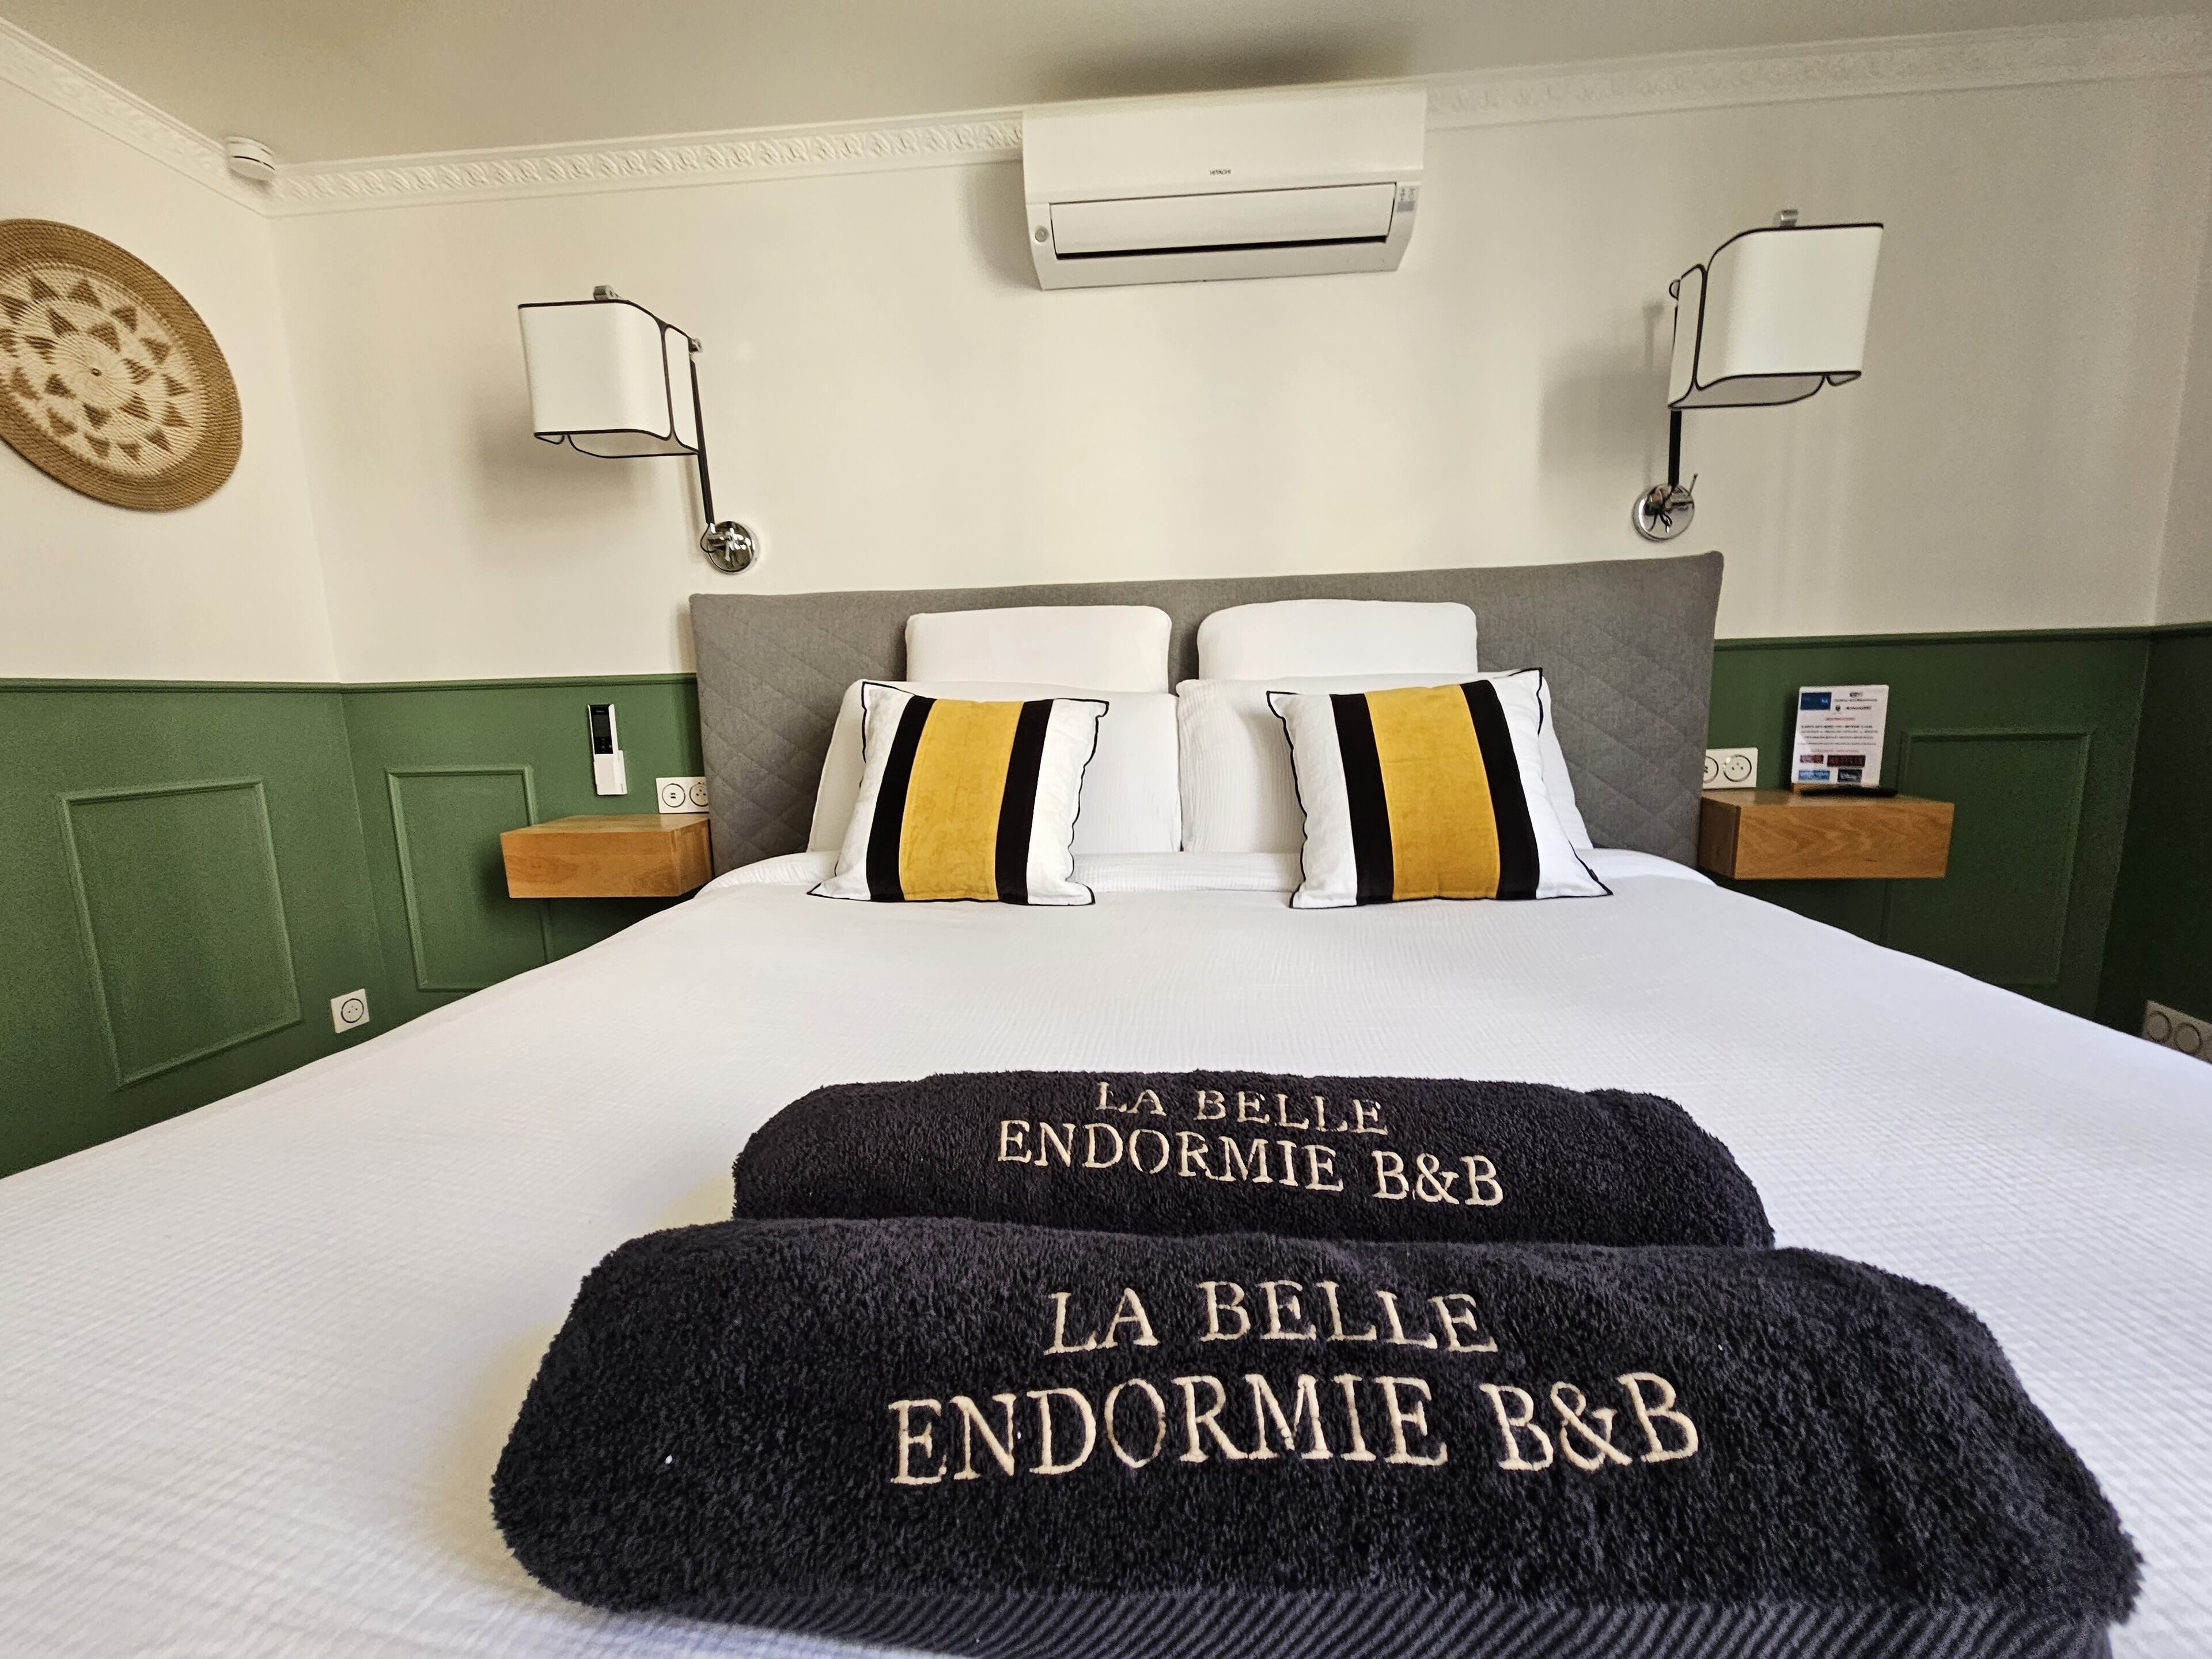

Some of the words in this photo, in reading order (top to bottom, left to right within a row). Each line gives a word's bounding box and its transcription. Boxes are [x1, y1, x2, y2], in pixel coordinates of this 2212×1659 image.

[1096, 1081, 1166, 1116] LA
[1193, 1089, 1388, 1135] BELLE
[997, 1119, 1344, 1192] ENDORMIE
[1371, 1150, 1503, 1206] B&B
[1043, 1288, 1159, 1355] LA
[1199, 1280, 1498, 1353] BELLE
[888, 1373, 1448, 1486] ENDORMIE
[1479, 1372, 1699, 1472] B&B
